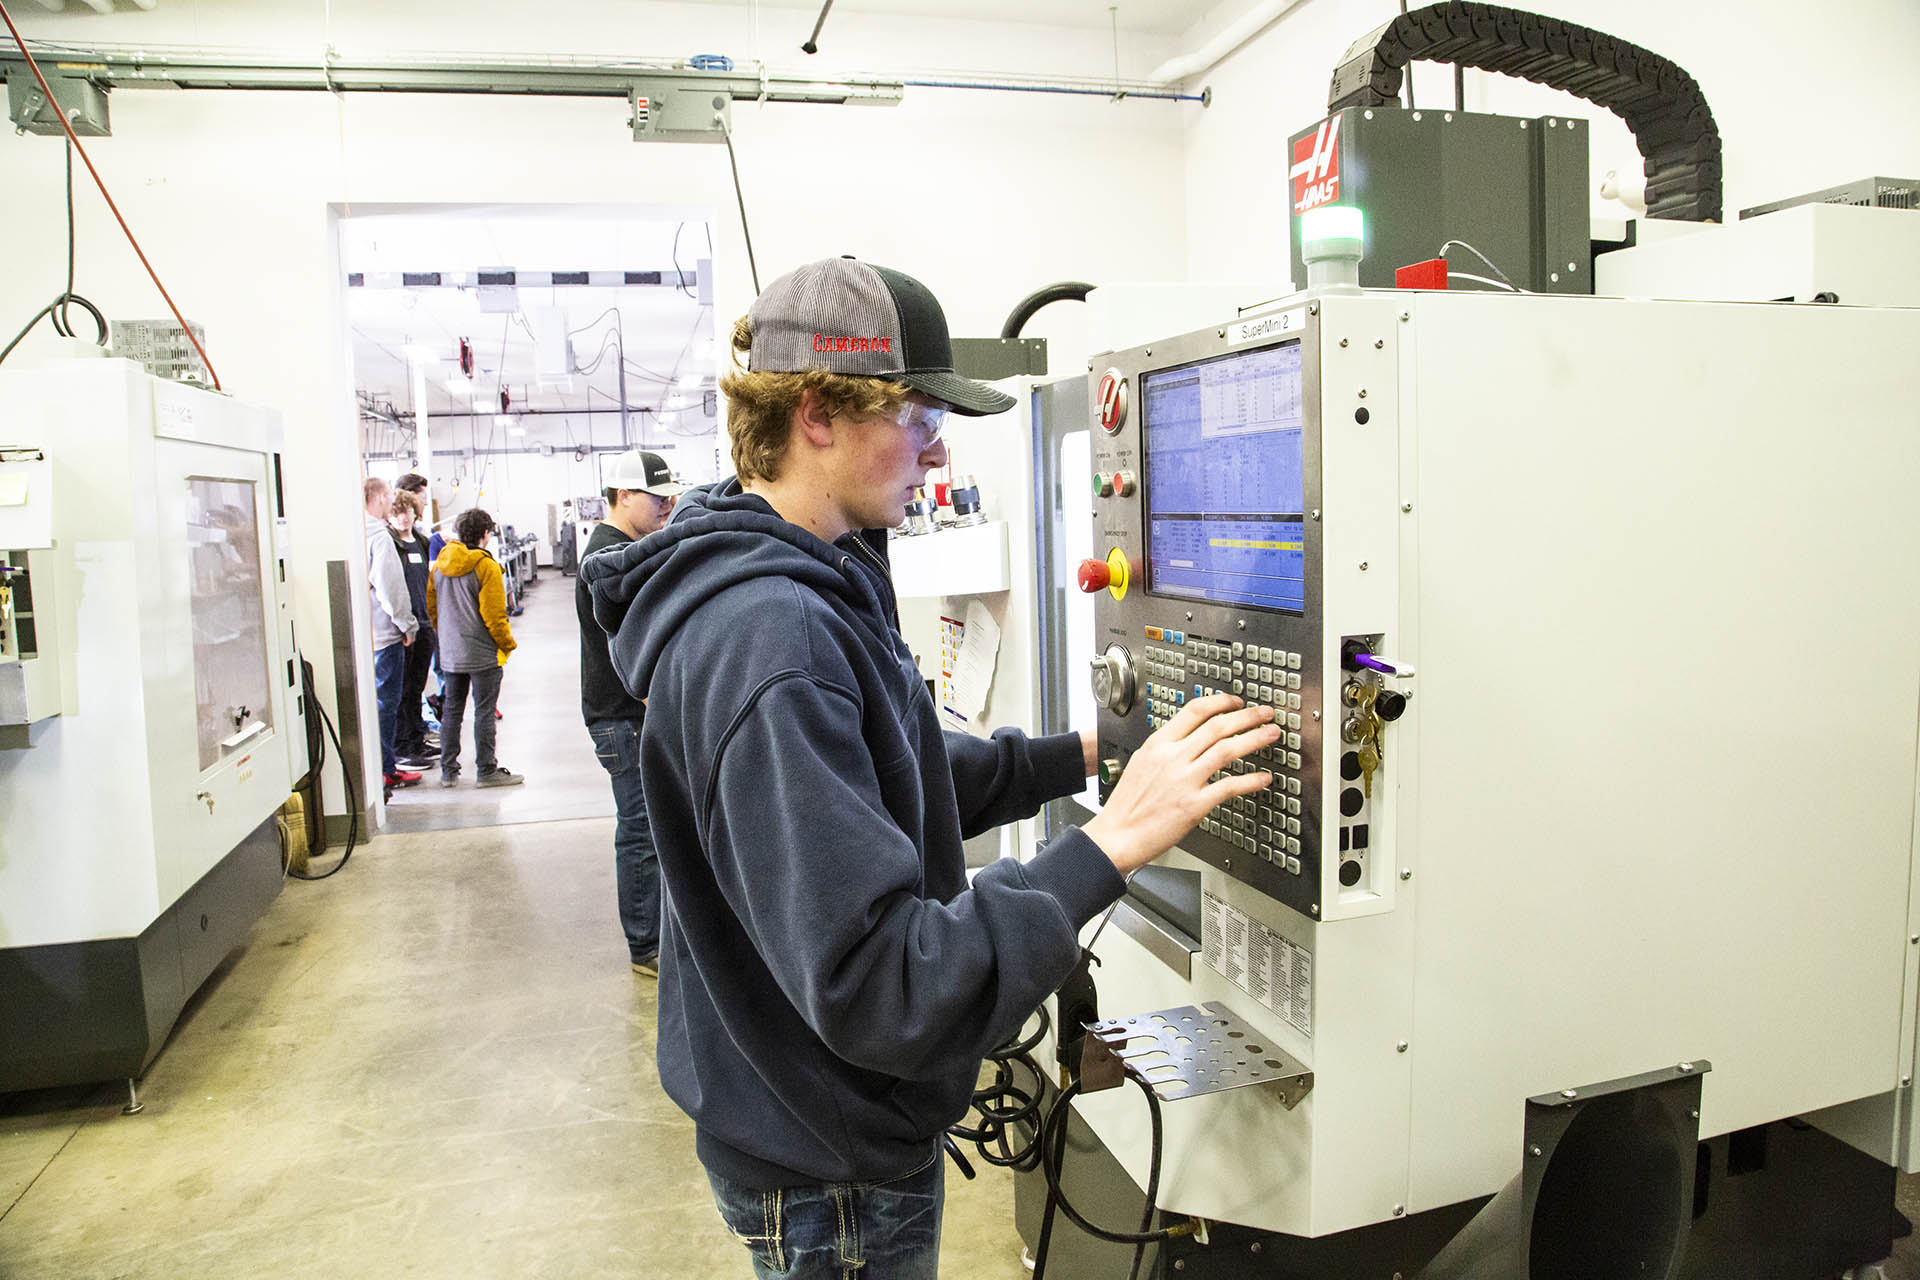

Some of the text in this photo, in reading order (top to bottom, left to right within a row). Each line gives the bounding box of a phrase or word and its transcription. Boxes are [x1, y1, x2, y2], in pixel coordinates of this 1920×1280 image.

[1294, 175, 1339, 211] HAAS
[1242, 314, 1289, 339] SuperMini 2
